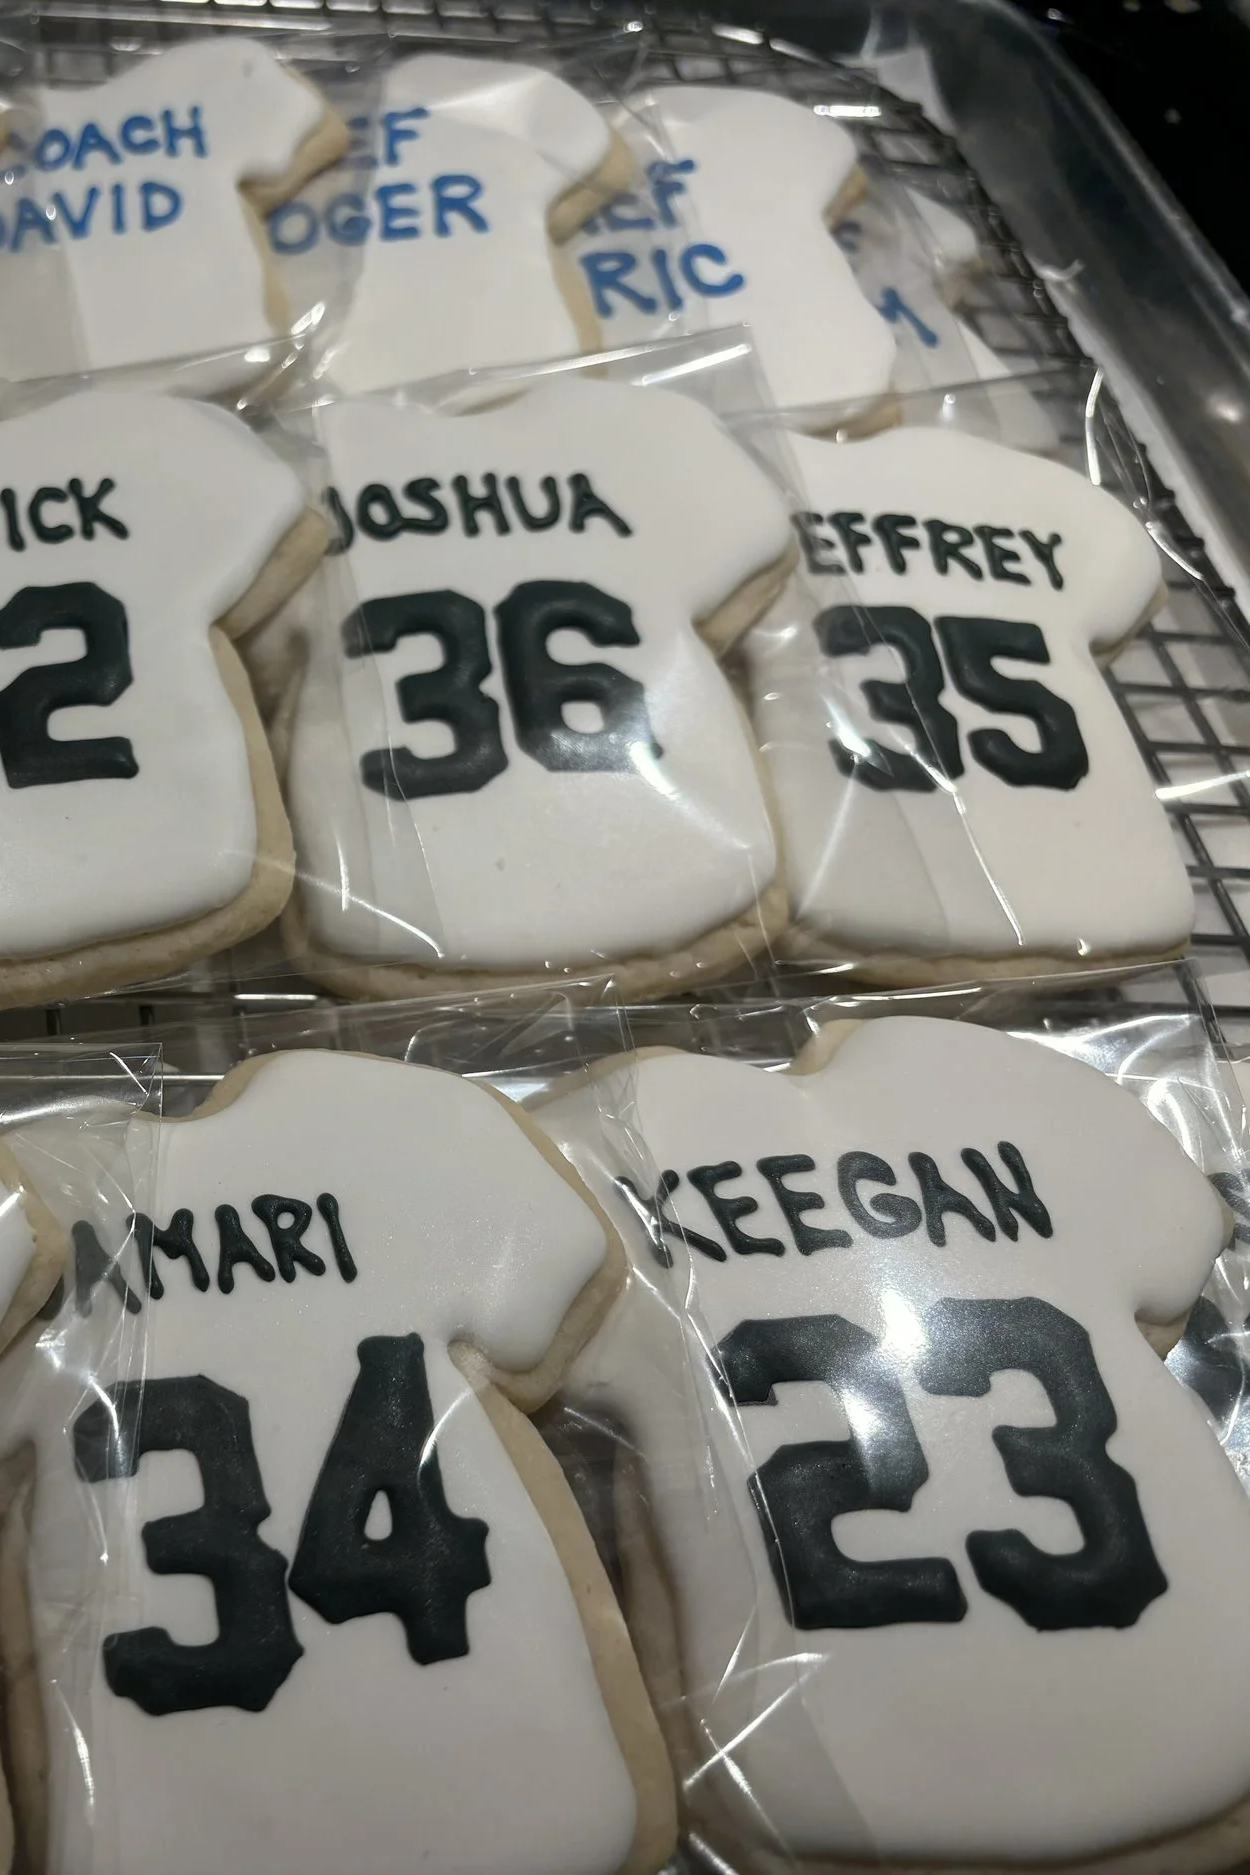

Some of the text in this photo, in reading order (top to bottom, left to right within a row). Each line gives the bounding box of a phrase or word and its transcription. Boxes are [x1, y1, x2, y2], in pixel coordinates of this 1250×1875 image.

[269, 173, 489, 256] OGER
[580, 243, 744, 319] RIC
[322, 472, 633, 556] JOSHUA
[789, 512, 1064, 590] EFFREY
[341, 580, 663, 801] 36
[813, 605, 1089, 793] 35
[38, 1192, 358, 1321] AMARI
[614, 1141, 1054, 1268] KEEGAN
[72, 1331, 492, 1716] 34
[711, 1296, 1169, 1633] 23
